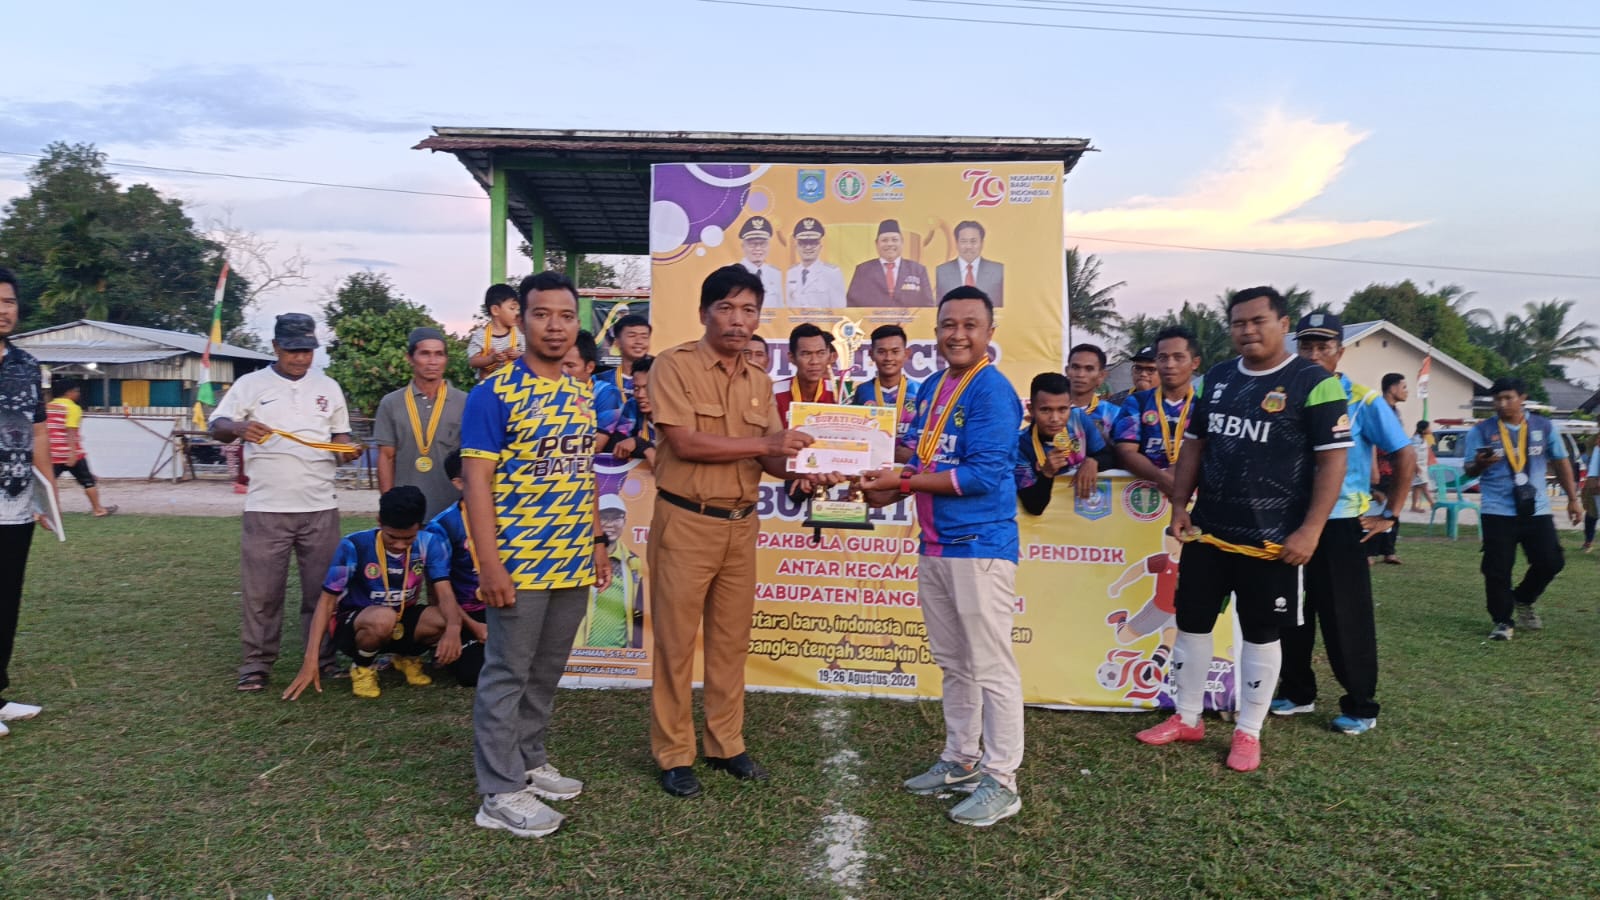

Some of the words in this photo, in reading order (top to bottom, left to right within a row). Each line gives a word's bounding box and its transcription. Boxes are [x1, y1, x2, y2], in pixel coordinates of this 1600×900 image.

[962, 169, 1005, 207] 79
[1223, 415, 1272, 443] BNI
[536, 435, 593, 458] PGR
[533, 457, 594, 477] BATE
[757, 533, 842, 550] PAKBOLA
[847, 537, 897, 553] GURU
[1029, 545, 1124, 563] PENDIDIK
[779, 560, 840, 576] ANTAR
[846, 563, 919, 579] KECAMA
[863, 589, 922, 606] BANG
[791, 612, 832, 633] baru,
[834, 614, 903, 636] indonesia
[801, 639, 855, 663] tengah
[857, 644, 918, 663] semakin
[847, 671, 889, 685] Agustus
[890, 674, 916, 687] 2024
